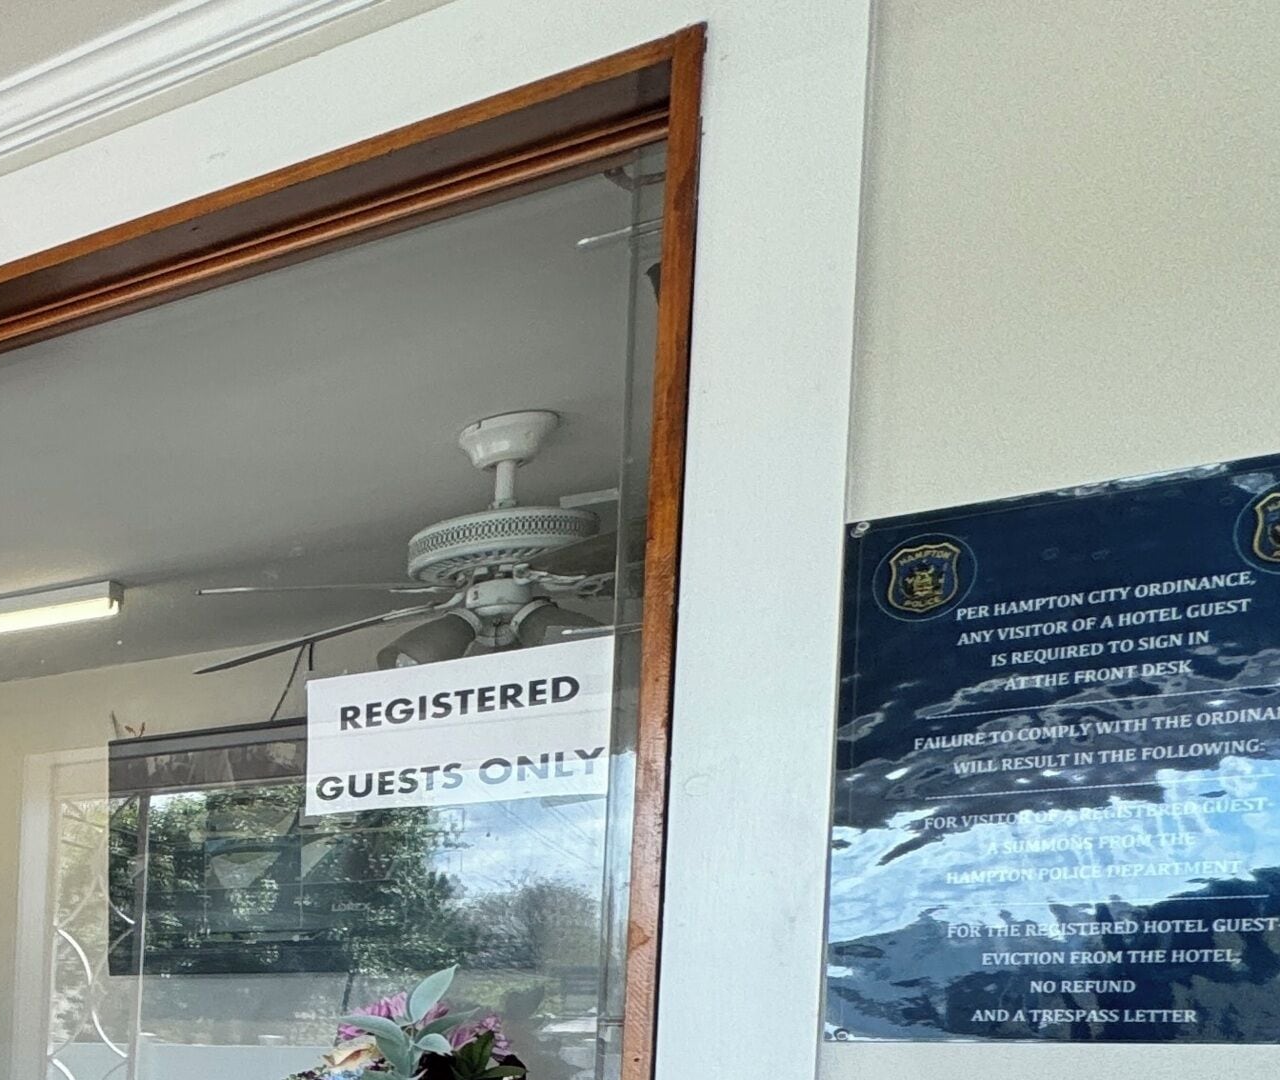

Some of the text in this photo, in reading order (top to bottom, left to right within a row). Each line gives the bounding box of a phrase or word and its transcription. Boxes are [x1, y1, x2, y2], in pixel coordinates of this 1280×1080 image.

[955, 571, 1257, 621] PER HAMPTON CITY ORDINANCE,
[956, 598, 1252, 646] ANY VISITOR OF A HOTEL GUEST
[991, 630, 1210, 668] IS REQUIRED TO SIGN IN
[1003, 659, 1192, 691] AT THE FRONT DESK
[340, 675, 580, 732] REGISTERED
[914, 706, 1280, 751] FAILURE TO COMPLY WITH THE ORDINA
[953, 738, 1266, 775] WILL RESULT IN THE FOLLOWING:
[315, 746, 606, 801] GUESTS ONLY
[924, 815, 958, 831] FOR
[961, 809, 1032, 828] VISITOR
[1002, 836, 1093, 854] SUMMONS
[1099, 833, 1152, 850] FROM
[1157, 831, 1196, 847] THE
[946, 860, 1243, 885] HAMPTON POLICE DEPARTMENT
[947, 925, 981, 939] FOR
[985, 924, 1021, 937] THE
[1025, 920, 1139, 937] REGISTERED
[1143, 919, 1209, 934] HOTEL
[981, 951, 1065, 966] EVICTION
[1069, 950, 1123, 965] FROM
[1126, 949, 1167, 964] THE
[1030, 980, 1136, 994] NO REFUND
[970, 1009, 1198, 1023] AND A TRESPASS LETTER
